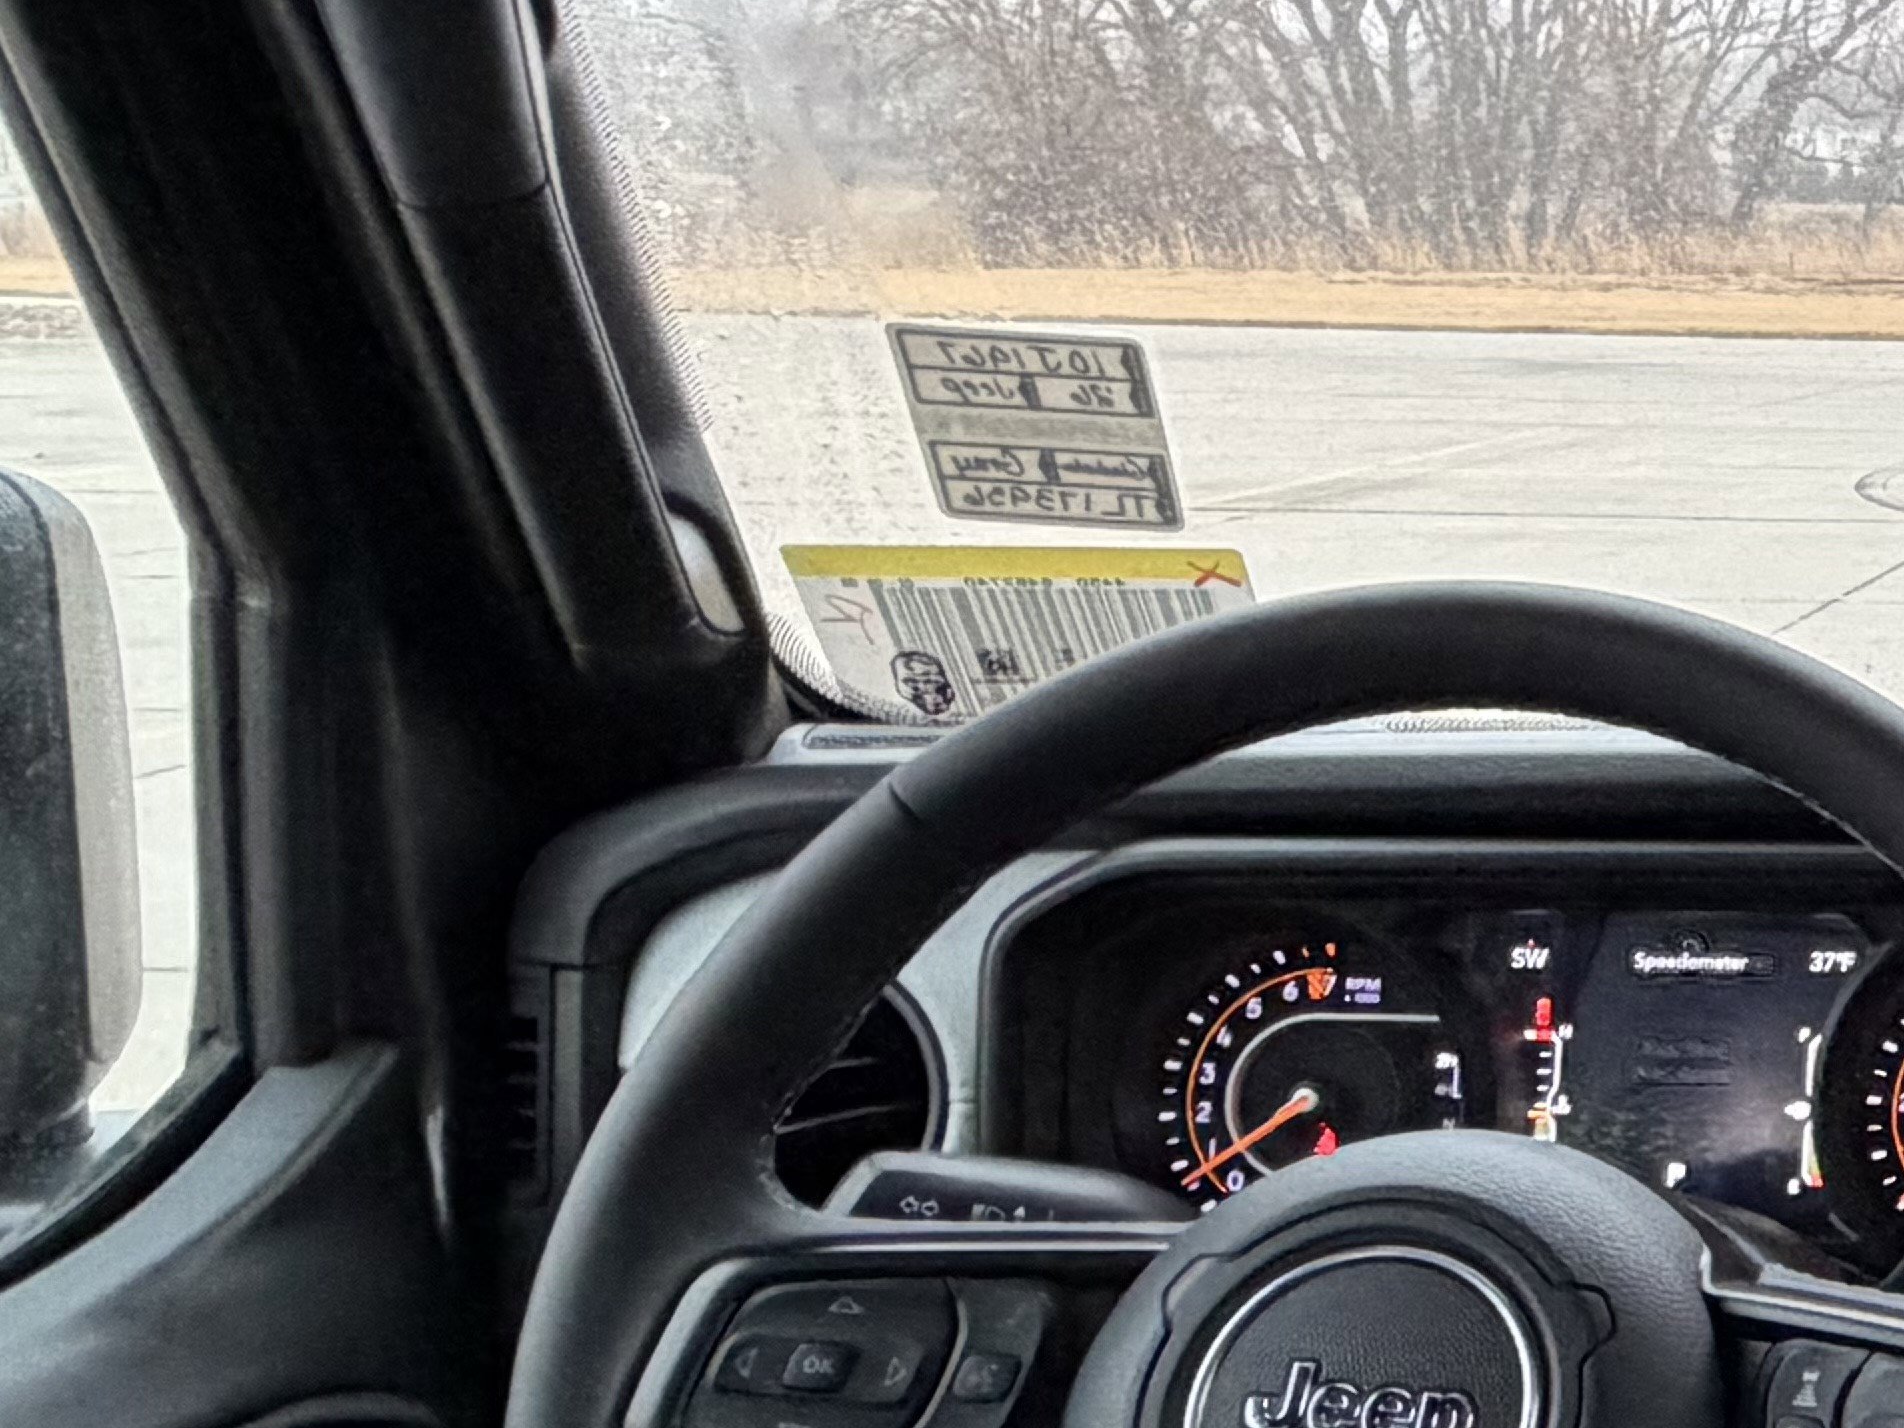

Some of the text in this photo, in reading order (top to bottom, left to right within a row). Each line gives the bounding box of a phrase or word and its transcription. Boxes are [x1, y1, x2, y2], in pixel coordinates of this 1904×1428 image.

[1510, 947, 1549, 970] SW
[1633, 951, 1749, 972] Speedometer
[1808, 951, 1857, 973] 37°F
[1282, 982, 1298, 1002] 6
[1345, 978, 1382, 991] RPM
[1246, 997, 1262, 1019] 5
[1200, 1063, 1216, 1084] 3
[1195, 1102, 1212, 1123] 2
[1227, 1170, 1245, 1192] 0
[1666, 1162, 1687, 1188] P
[802, 1355, 834, 1374] OK
